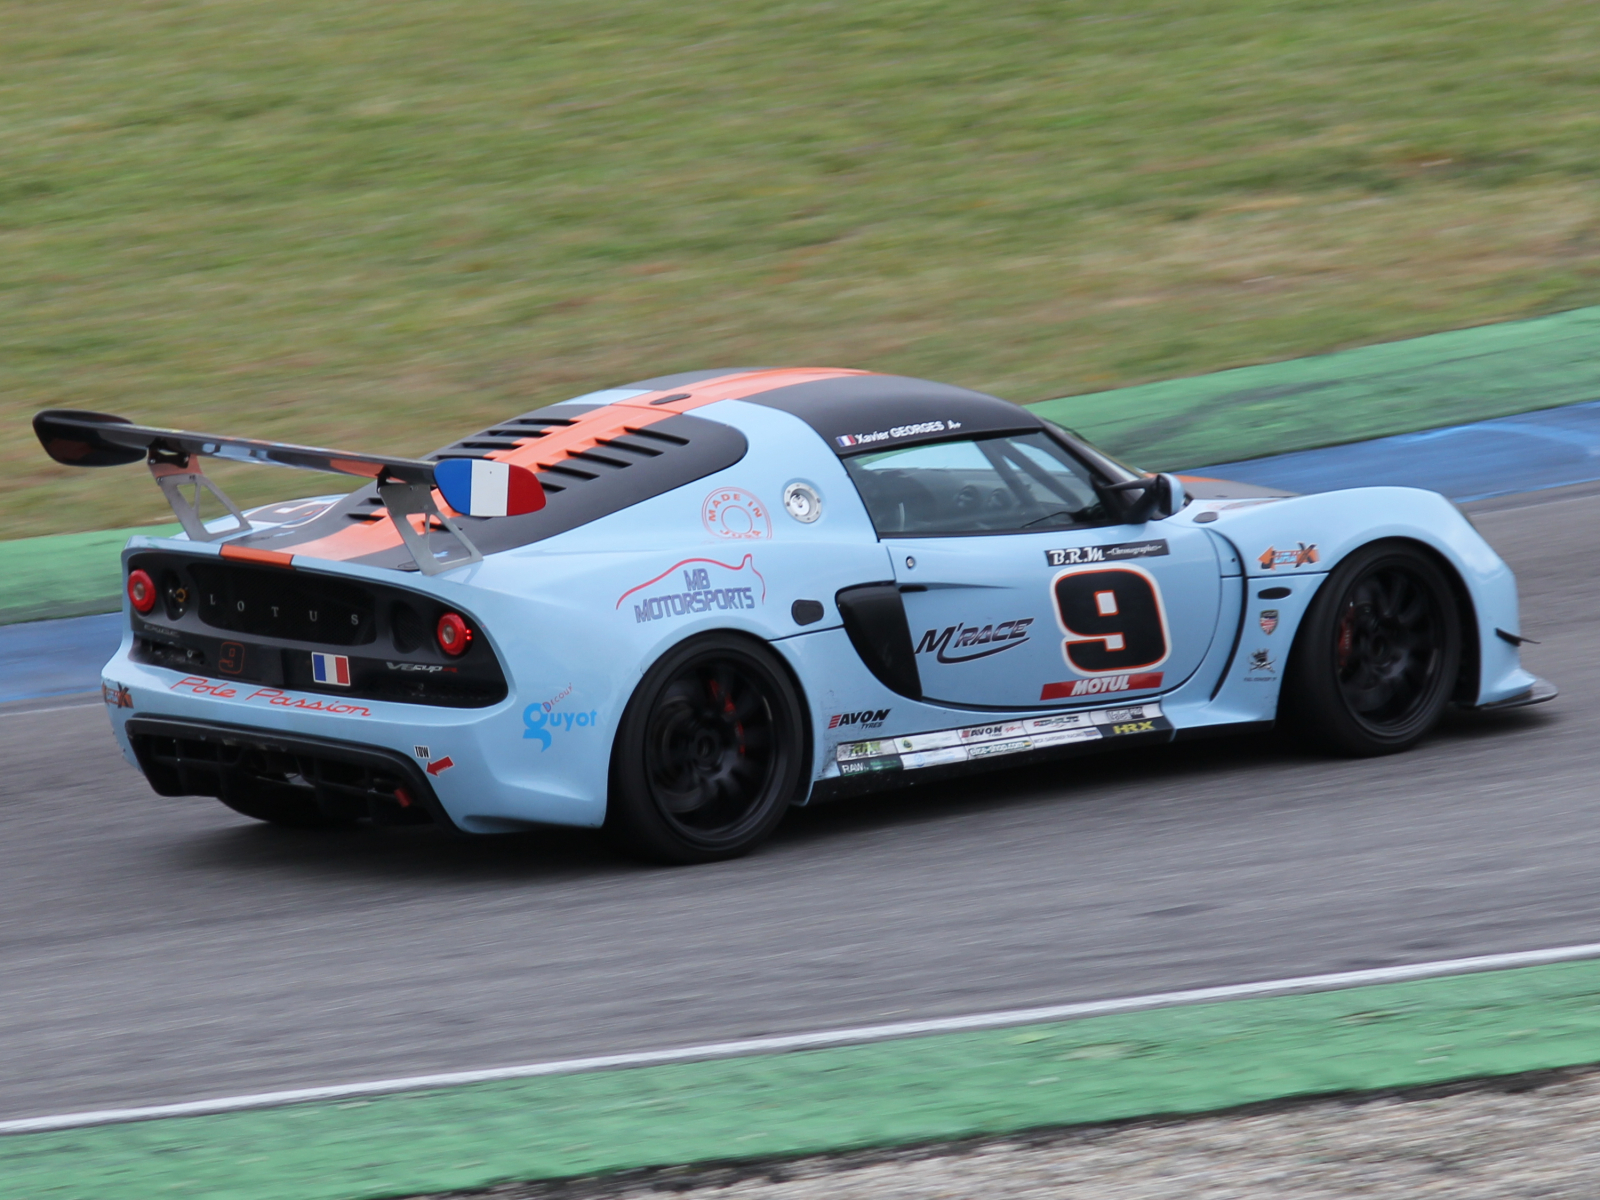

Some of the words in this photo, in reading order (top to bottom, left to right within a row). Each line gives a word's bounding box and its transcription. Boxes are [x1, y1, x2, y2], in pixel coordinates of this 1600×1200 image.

[855, 430, 889, 445] Xavier
[890, 420, 945, 438] GEORGES
[708, 493, 741, 522] MADE
[747, 501, 763, 518] IN
[683, 568, 710, 591] MB
[209, 593, 359, 626] LOTUS
[634, 587, 756, 623] MOTORSPORTS
[1053, 566, 1168, 673] 9
[218, 641, 245, 675] 9
[169, 676, 237, 698] Pole
[244, 687, 371, 717] Passion
[1071, 674, 1131, 697] MOTUL
[522, 702, 598, 753] guyot
[838, 708, 892, 727] AVON
[861, 721, 884, 730] TYRES
[970, 726, 1003, 738] AVON
[415, 745, 430, 758] TOW
